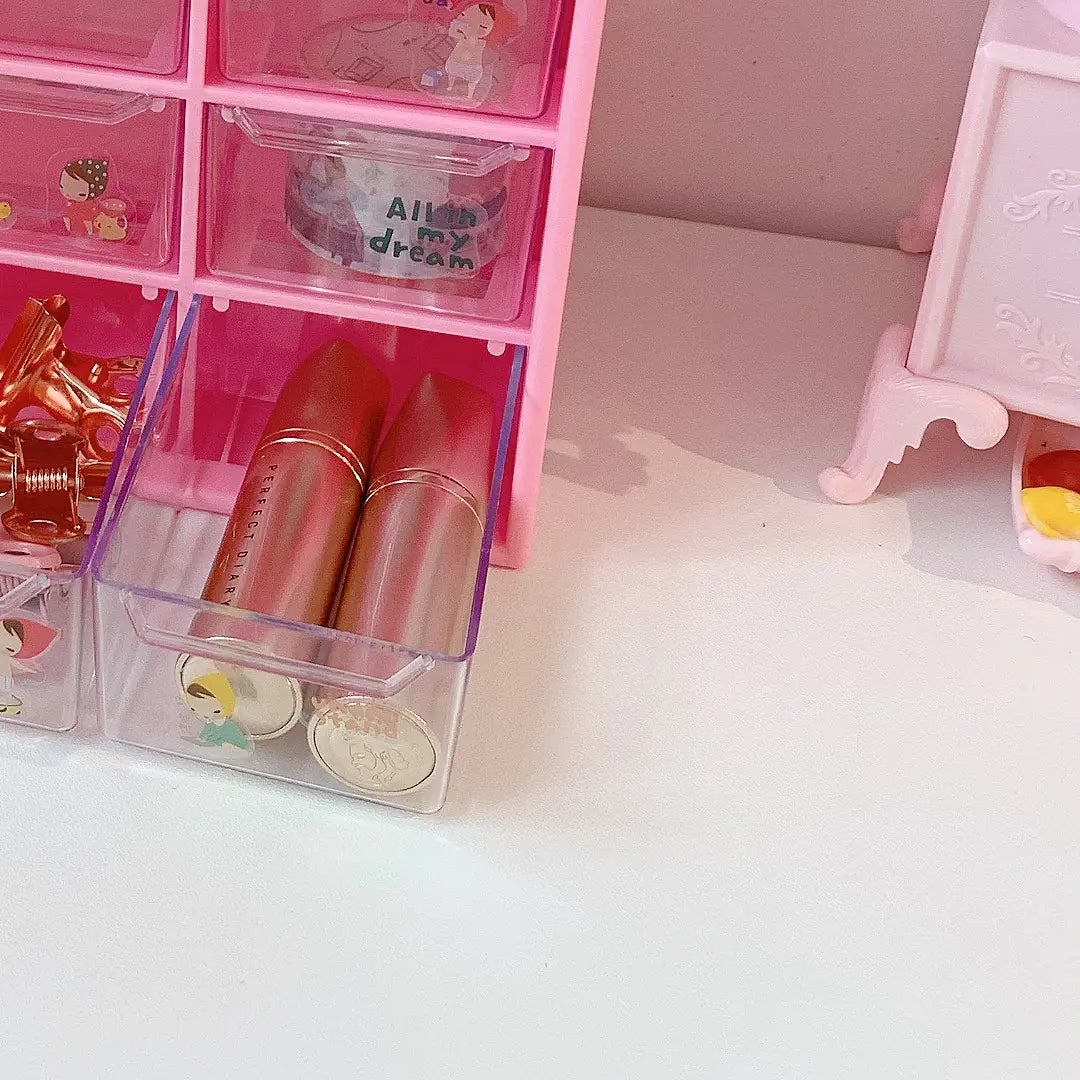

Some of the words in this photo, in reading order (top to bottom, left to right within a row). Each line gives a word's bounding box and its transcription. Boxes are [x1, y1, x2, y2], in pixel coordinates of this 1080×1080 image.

[386, 196, 433, 222] All
[369, 228, 474, 270] dream
[417, 226, 470, 253] my
[243, 464, 278, 540] PERFECT
[221, 550, 248, 606] DIARY
